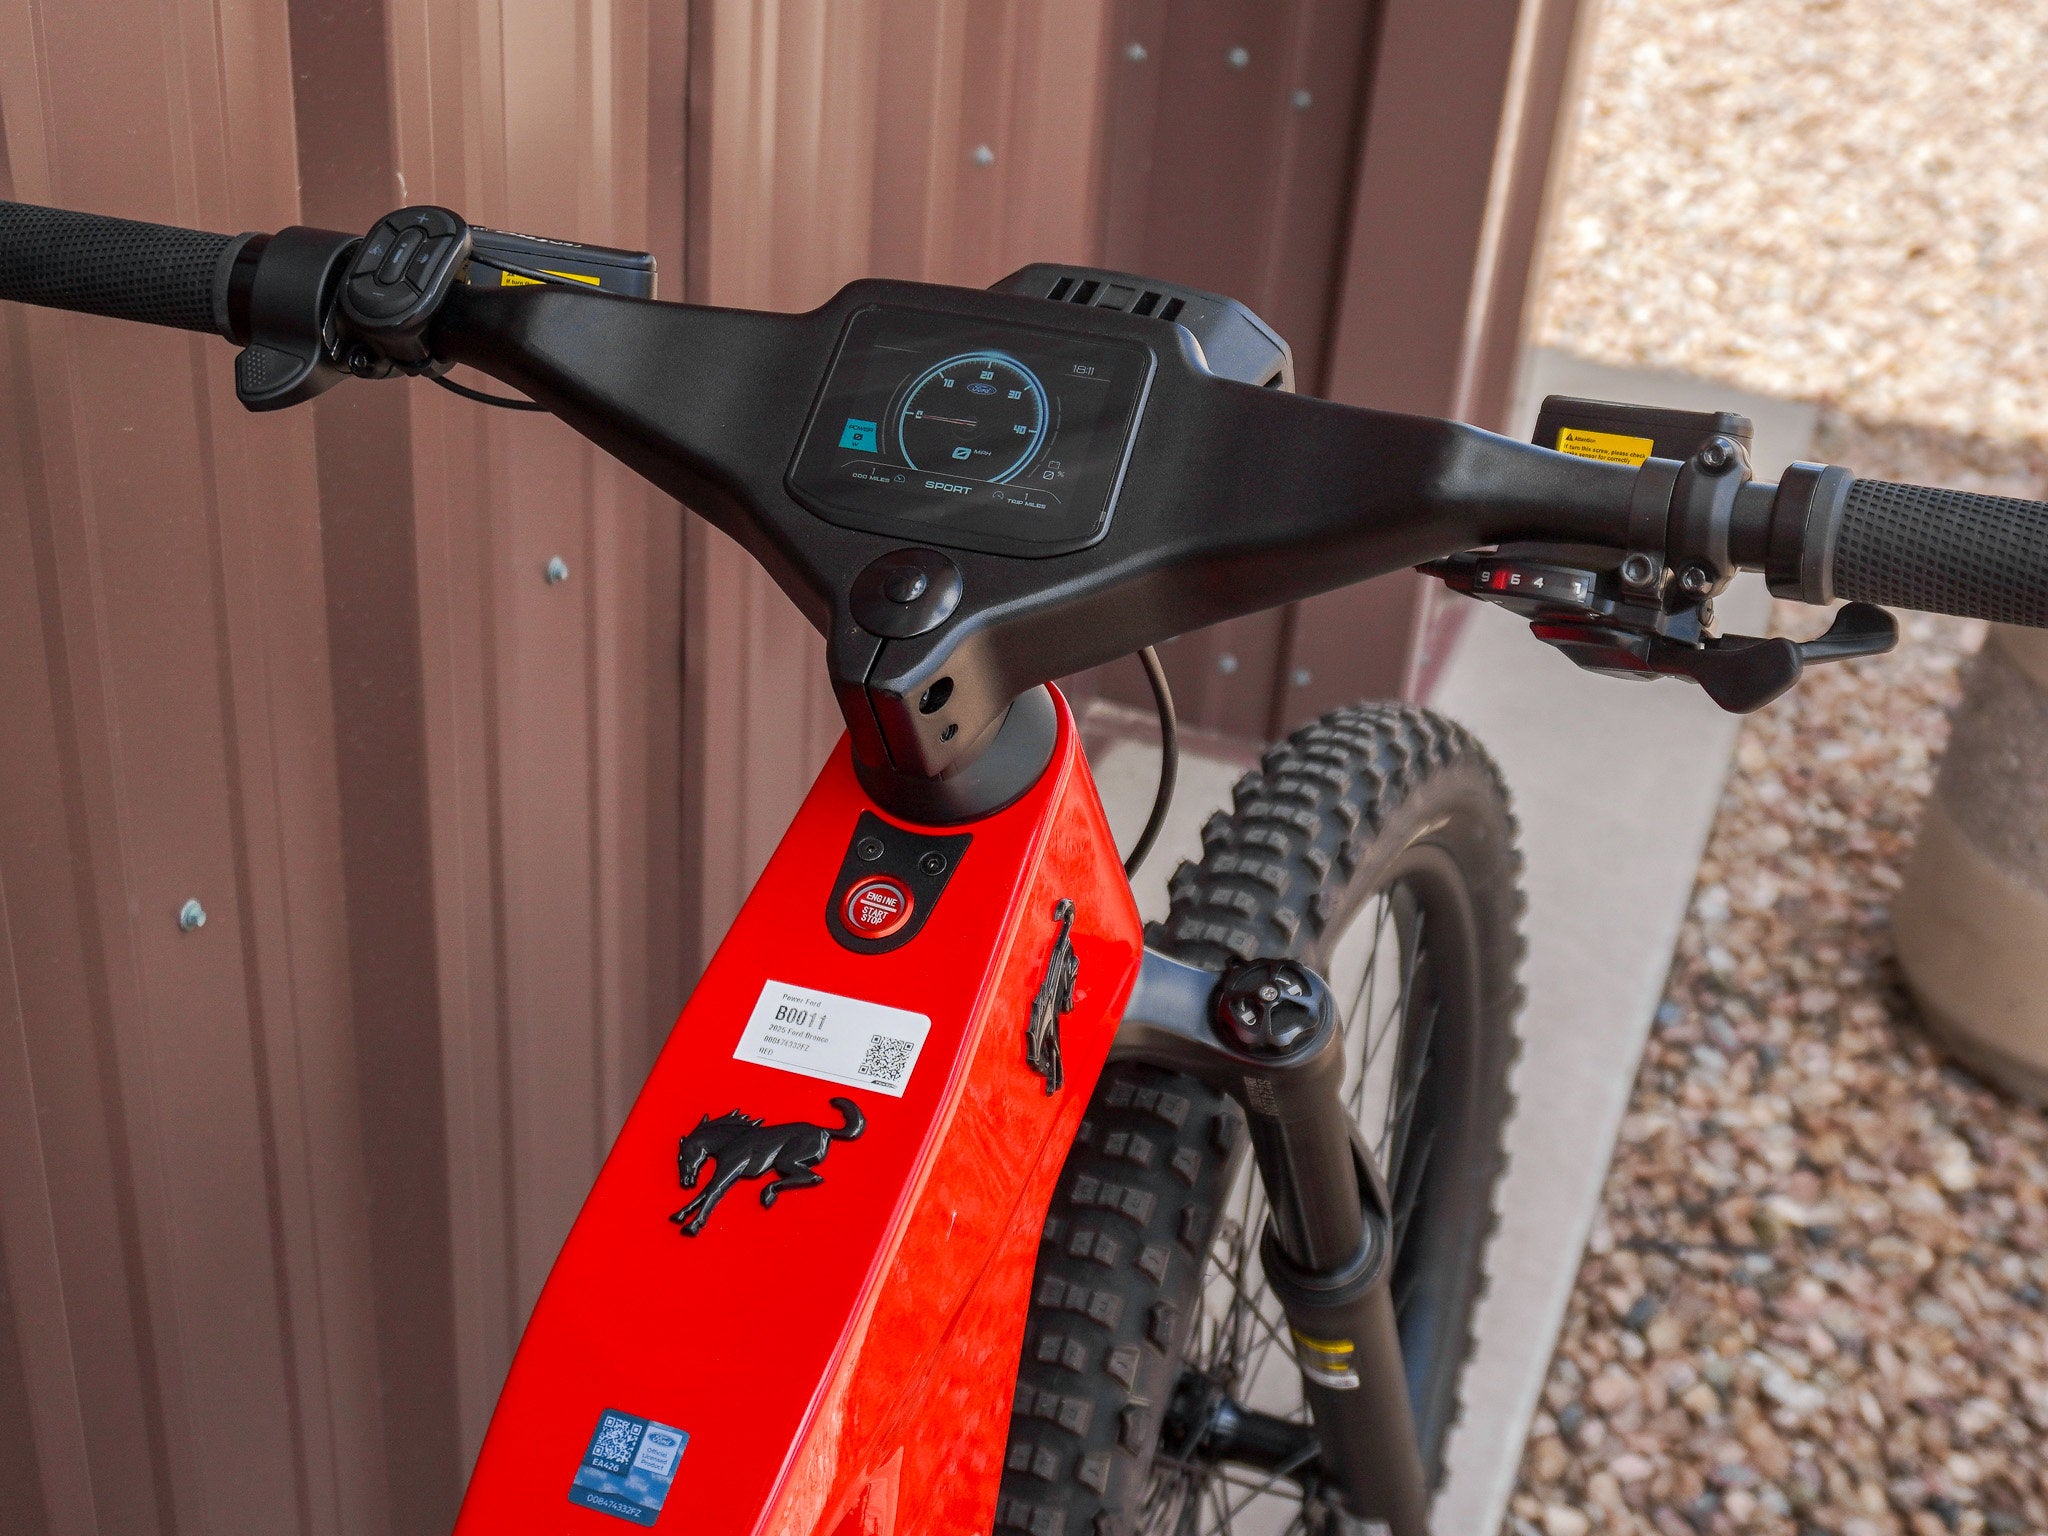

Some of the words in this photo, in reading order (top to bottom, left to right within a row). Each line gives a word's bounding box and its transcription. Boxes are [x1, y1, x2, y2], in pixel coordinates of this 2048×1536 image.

[980, 370, 994, 380] 20
[1073, 364, 1095, 376] 18:11
[943, 378, 954, 388] 10
[1008, 390, 1022, 400] 30
[848, 424, 874, 432] POWER
[1014, 424, 1027, 434] 40
[1607, 456, 1630, 464] correctly
[869, 475, 890, 483] MILES
[924, 480, 972, 494] SPORT
[1025, 501, 1046, 510] MILES
[1481, 572, 1490, 582] 9
[1510, 574, 1521, 584] 6
[1534, 578, 1544, 588] 4
[1574, 582, 1582, 595] 1
[866, 892, 898, 907] ENGINE
[862, 906, 888, 920] START
[860, 914, 882, 926] STOP
[782, 994, 804, 1004] Power
[805, 999, 822, 1008] Ford
[775, 1005, 826, 1030] B0011
[768, 1024, 786, 1033] 2025
[788, 1028, 804, 1037] Ford
[804, 1032, 830, 1043] Bronco
[758, 1047, 774, 1056] RED
[592, 1458, 620, 1472] EA426
